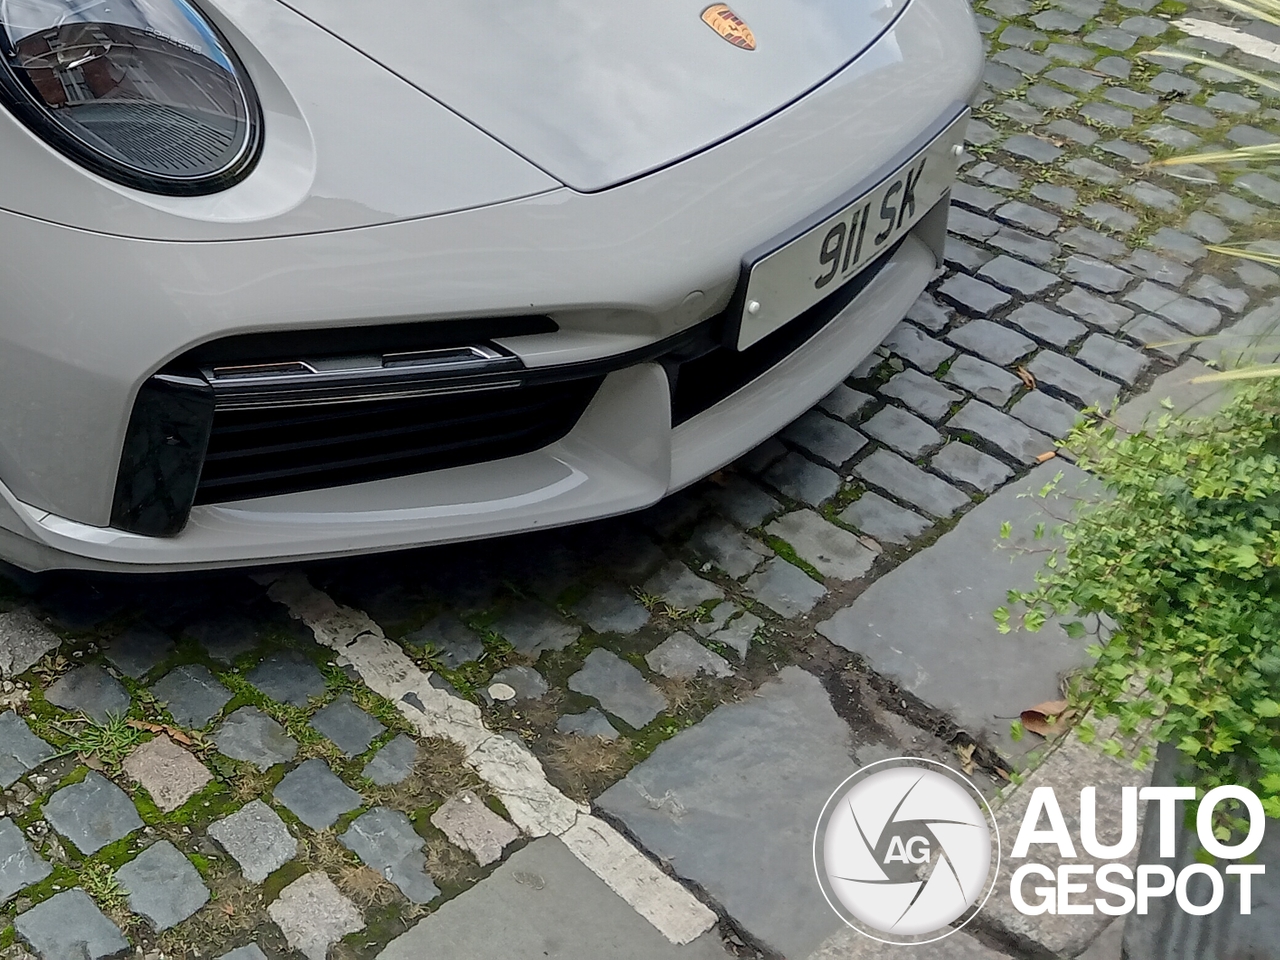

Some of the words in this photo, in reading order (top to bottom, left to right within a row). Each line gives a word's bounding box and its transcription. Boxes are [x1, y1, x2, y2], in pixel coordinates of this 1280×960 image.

[145, 26, 202, 52] PORSCHE
[814, 202, 871, 290] 911
[874, 157, 927, 244] SK
